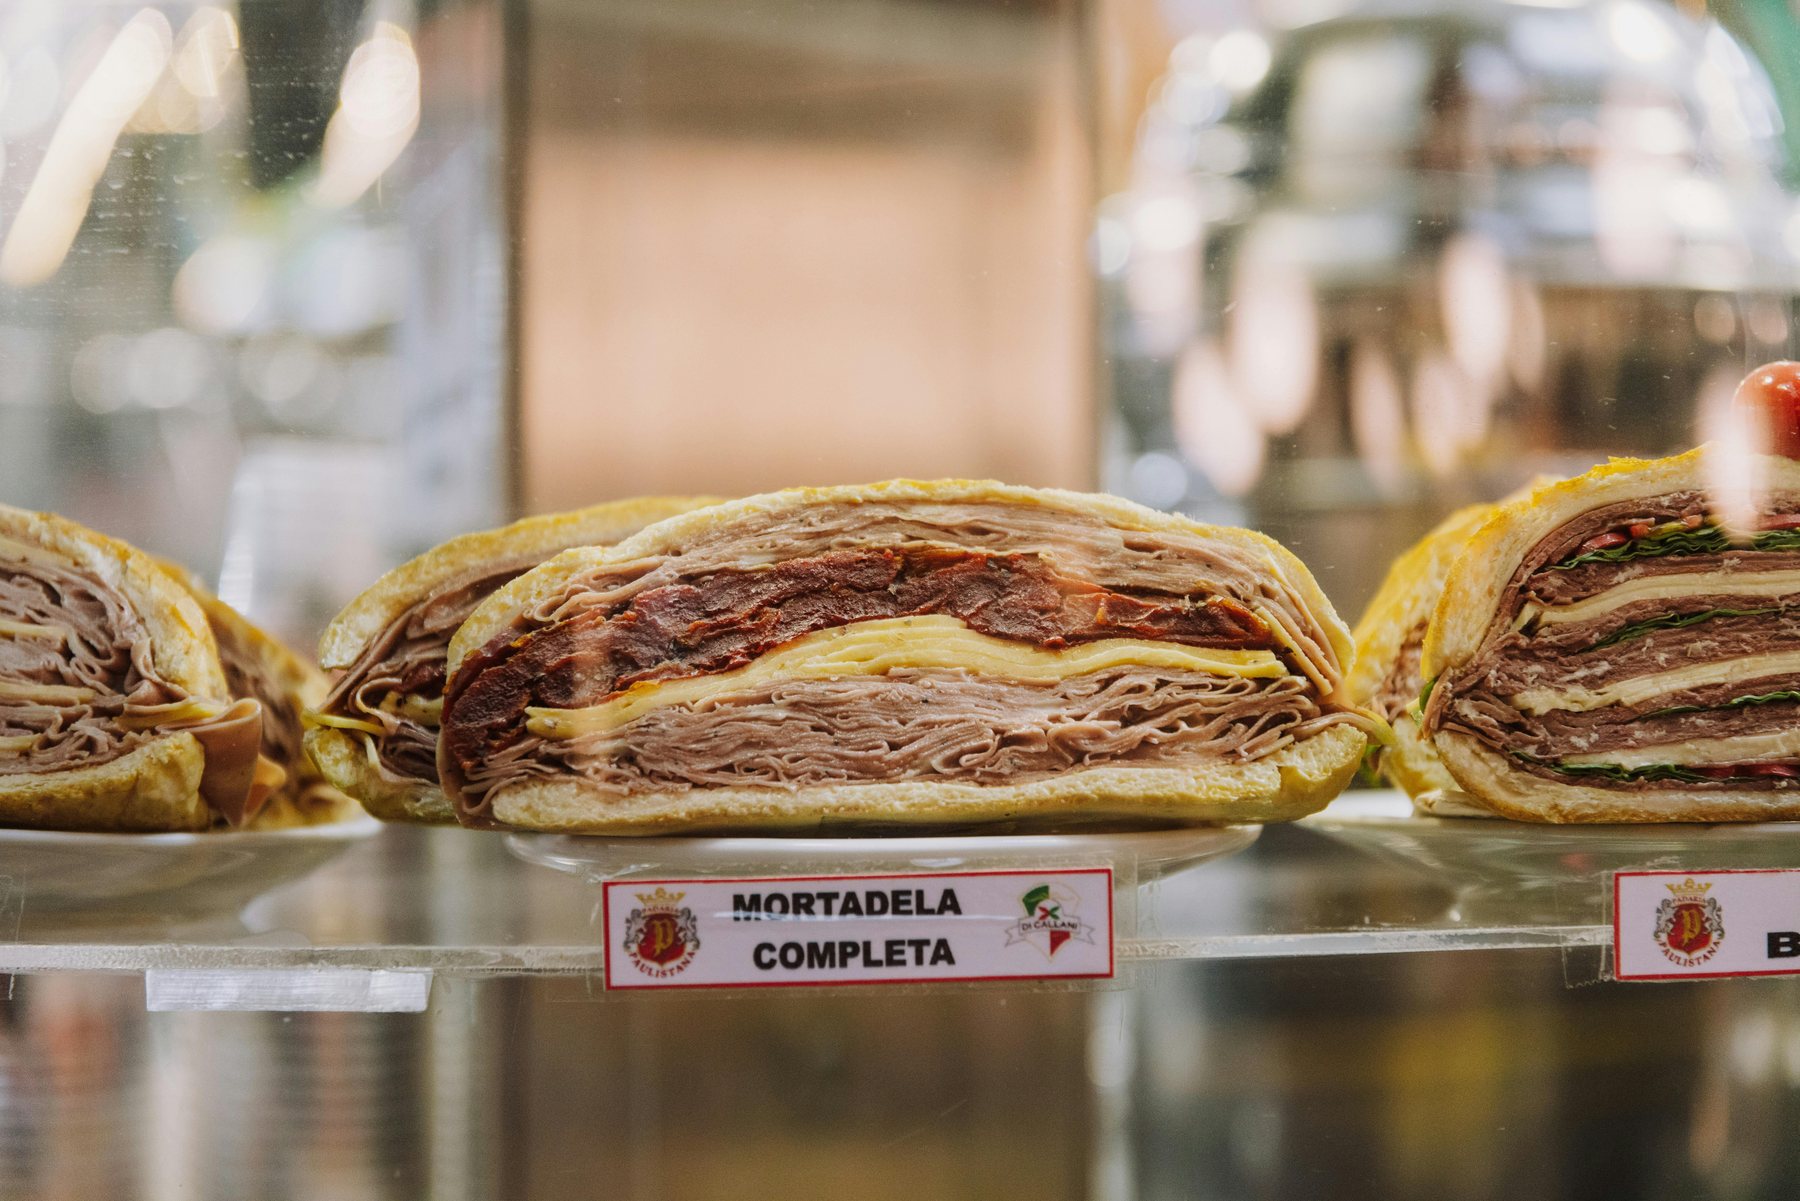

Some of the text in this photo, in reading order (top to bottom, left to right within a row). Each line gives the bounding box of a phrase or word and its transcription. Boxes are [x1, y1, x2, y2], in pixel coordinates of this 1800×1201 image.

[732, 888, 962, 921] MORTADELA
[1021, 920, 1078, 931] DI CALLANI
[629, 949, 697, 979] PAULISTANA
[753, 938, 956, 970] COMPLETA
[1657, 939, 1722, 968] PAULISTANA
